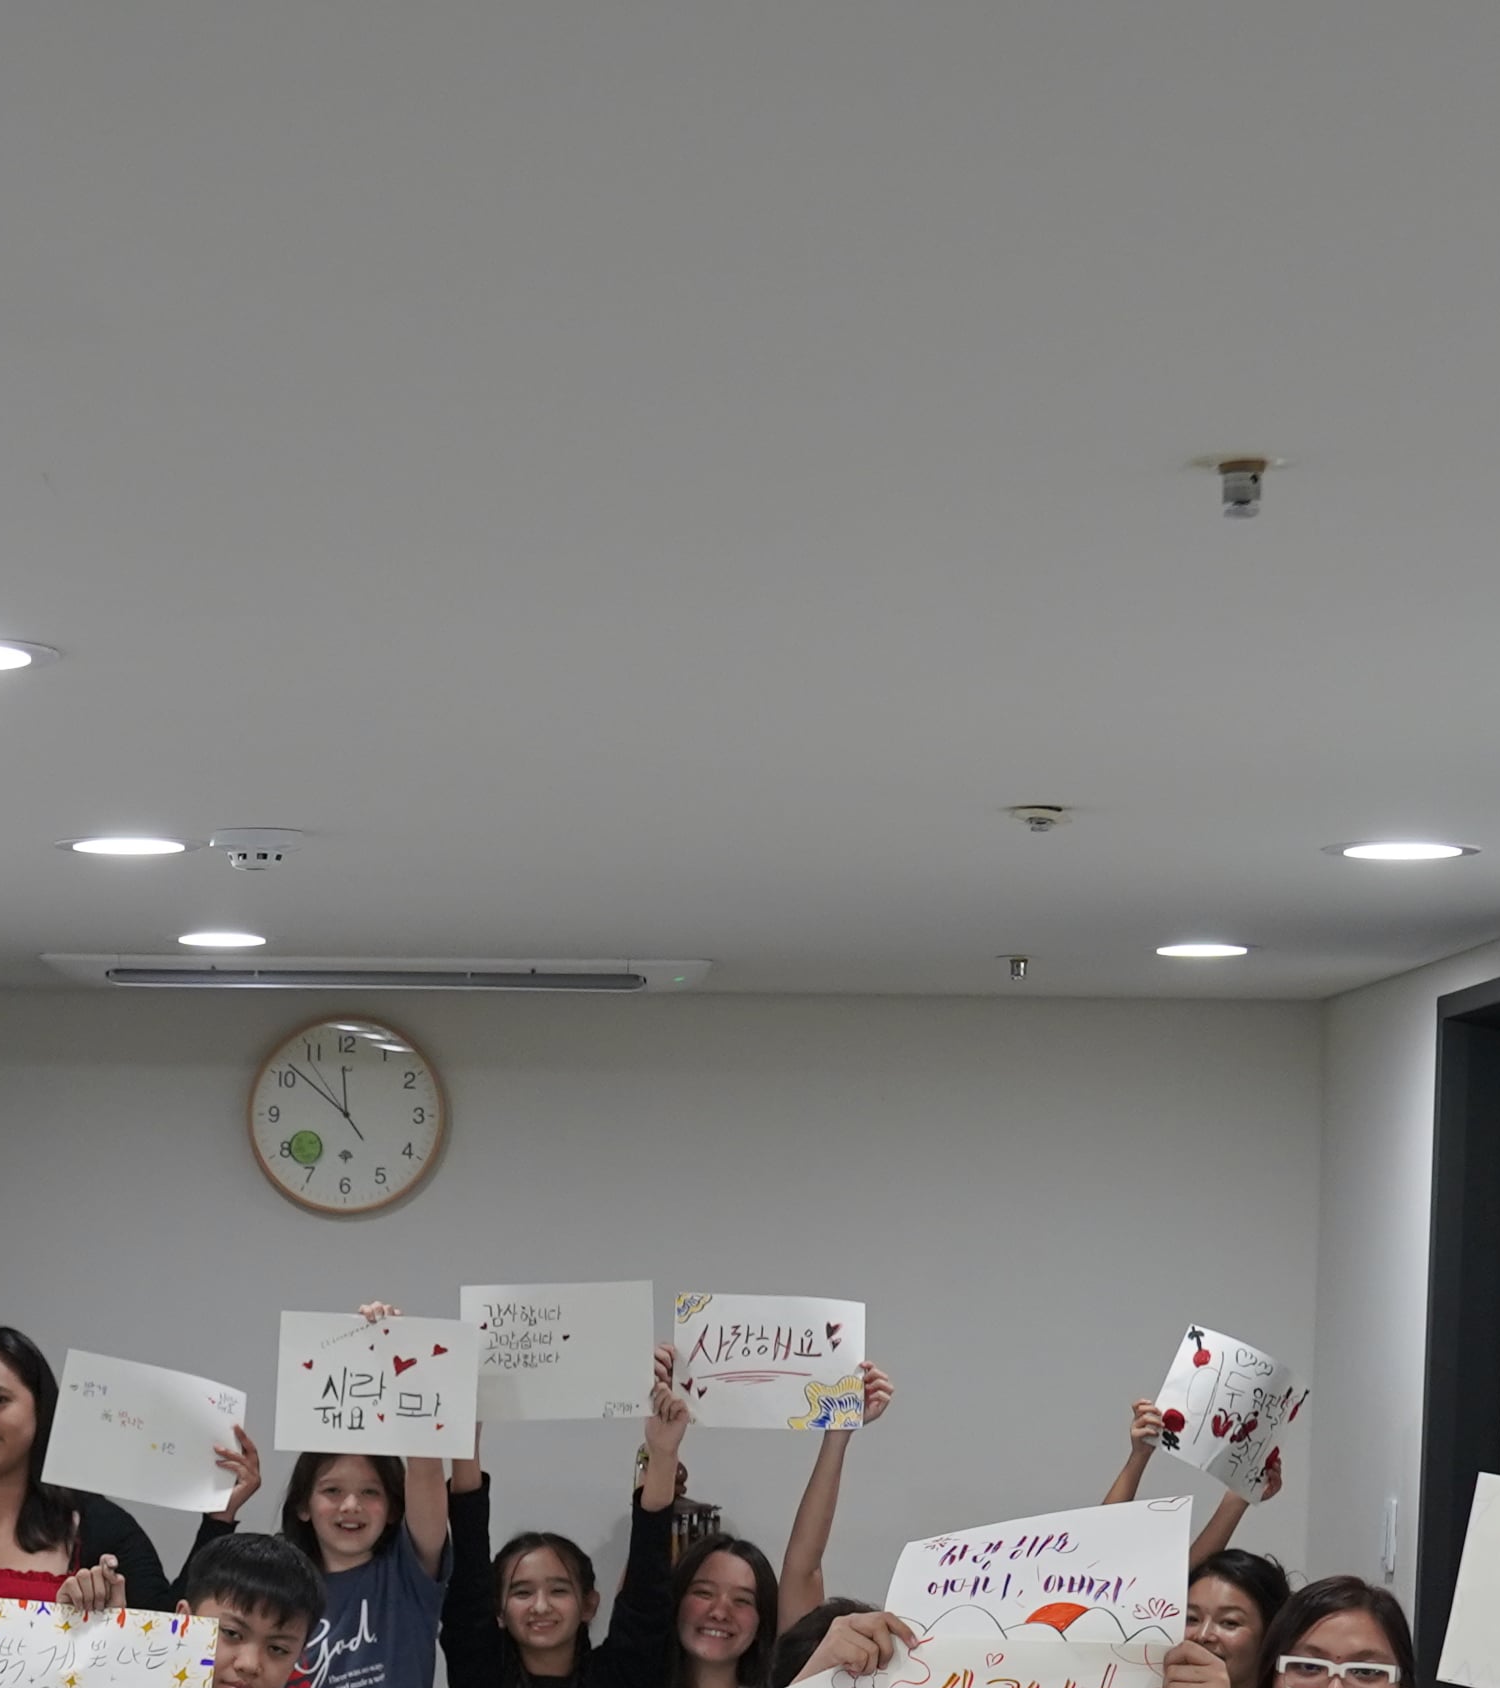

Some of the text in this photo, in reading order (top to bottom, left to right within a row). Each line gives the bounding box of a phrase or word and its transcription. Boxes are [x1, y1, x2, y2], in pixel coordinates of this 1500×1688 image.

[306, 1043, 322, 1062] 11
[337, 1036, 356, 1053] 12
[277, 1070, 296, 1088] 10
[403, 1072, 416, 1089] 2
[268, 1105, 280, 1123] 9
[412, 1107, 425, 1124] 3
[279, 1141, 292, 1158] 8
[402, 1143, 414, 1159] 4
[303, 1166, 315, 1183] 7
[374, 1167, 387, 1184] 5
[339, 1178, 351, 1194] 6
[483, 1303, 562, 1327] 감사합니다
[485, 1330, 553, 1350] 고맙습니다
[687, 1323, 823, 1366] 사랑해요
